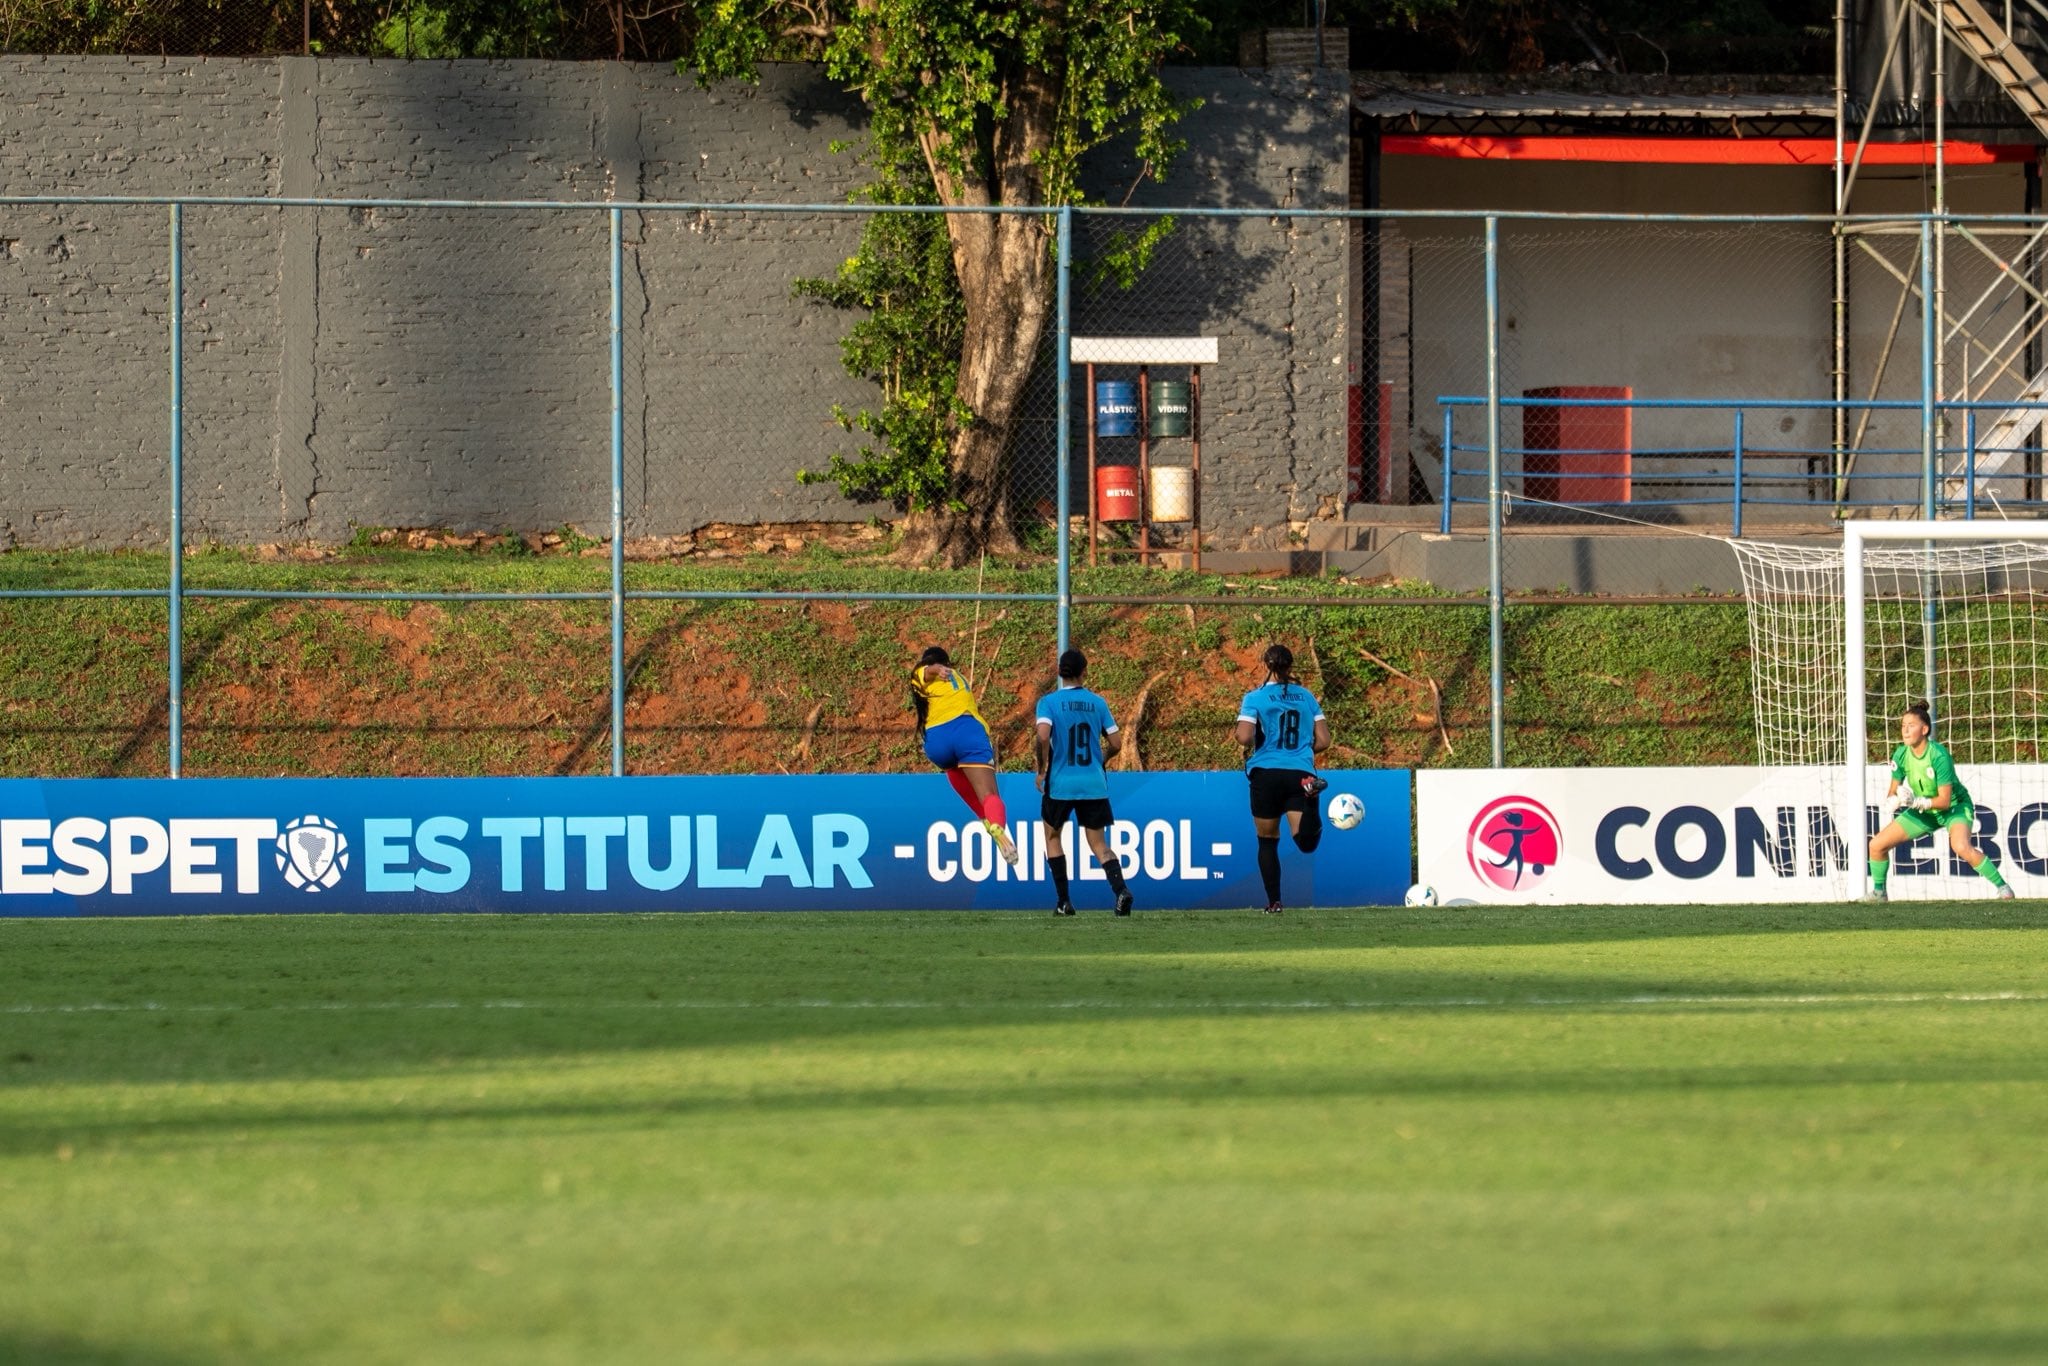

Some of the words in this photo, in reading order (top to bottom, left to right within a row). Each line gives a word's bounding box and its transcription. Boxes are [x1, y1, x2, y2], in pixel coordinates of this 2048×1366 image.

[1158, 405, 1188, 414] VIDRIO
[1106, 488, 1135, 497] METAL
[1067, 722, 1093, 767] 19
[1276, 709, 1301, 751] 18
[364, 815, 472, 894] ES
[482, 813, 875, 892] TITULAR
